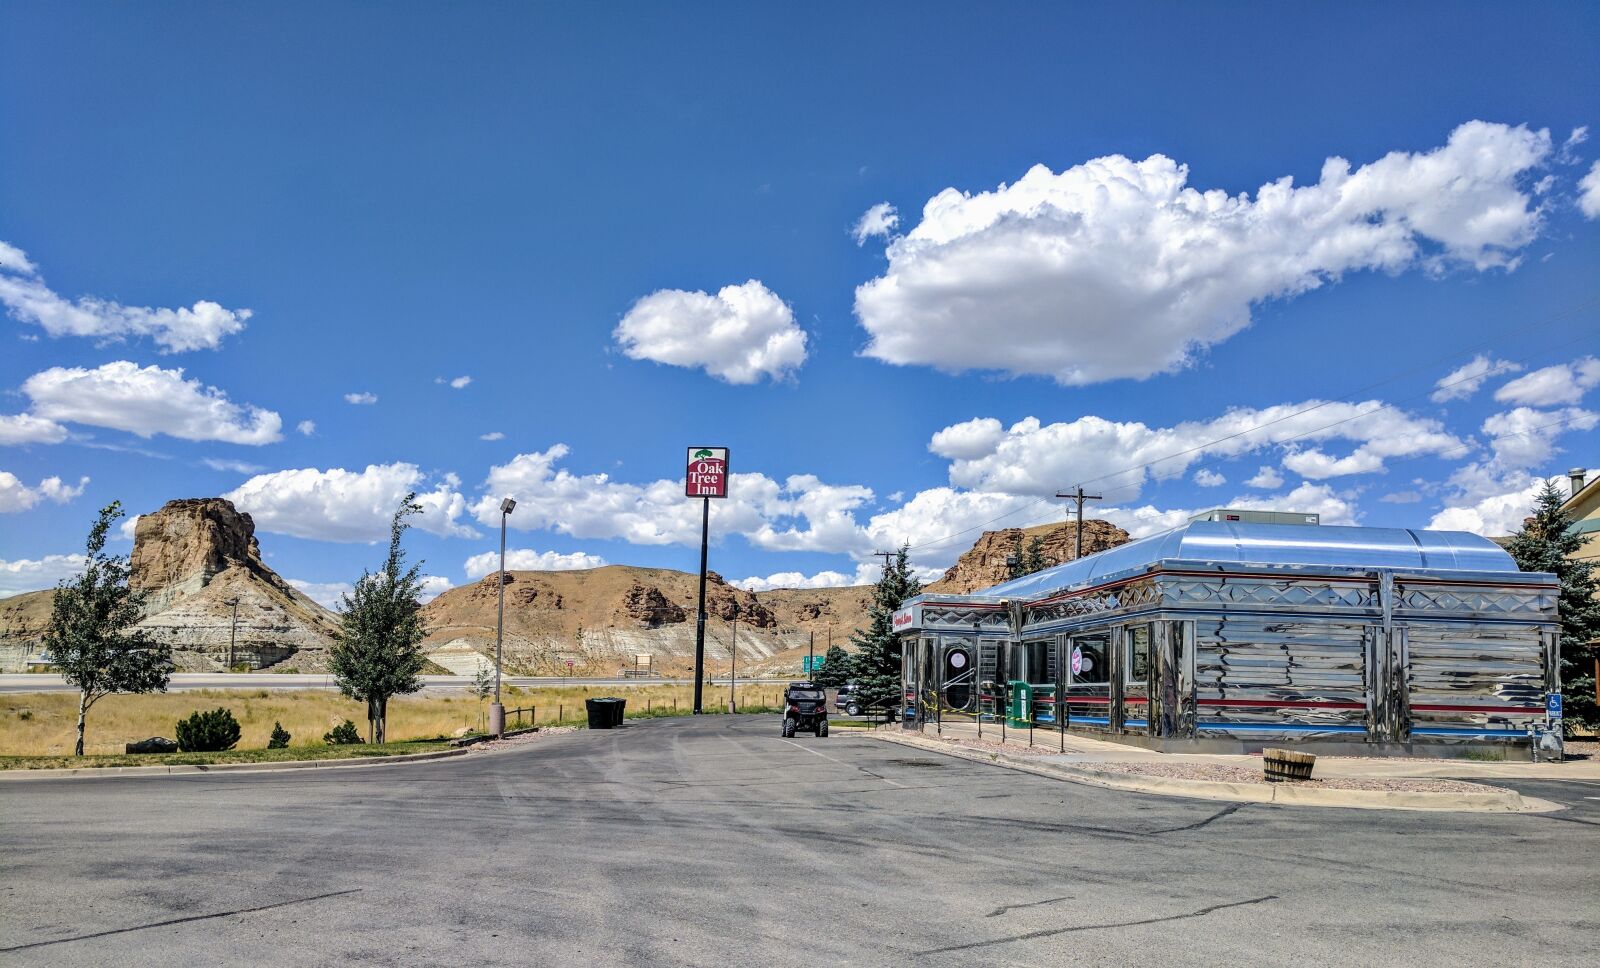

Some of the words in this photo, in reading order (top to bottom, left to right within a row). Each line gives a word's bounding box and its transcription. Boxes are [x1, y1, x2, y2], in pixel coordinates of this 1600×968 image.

[697, 462, 724, 474] Oak
[689, 471, 718, 484] Tree
[696, 483, 717, 495] Inn
